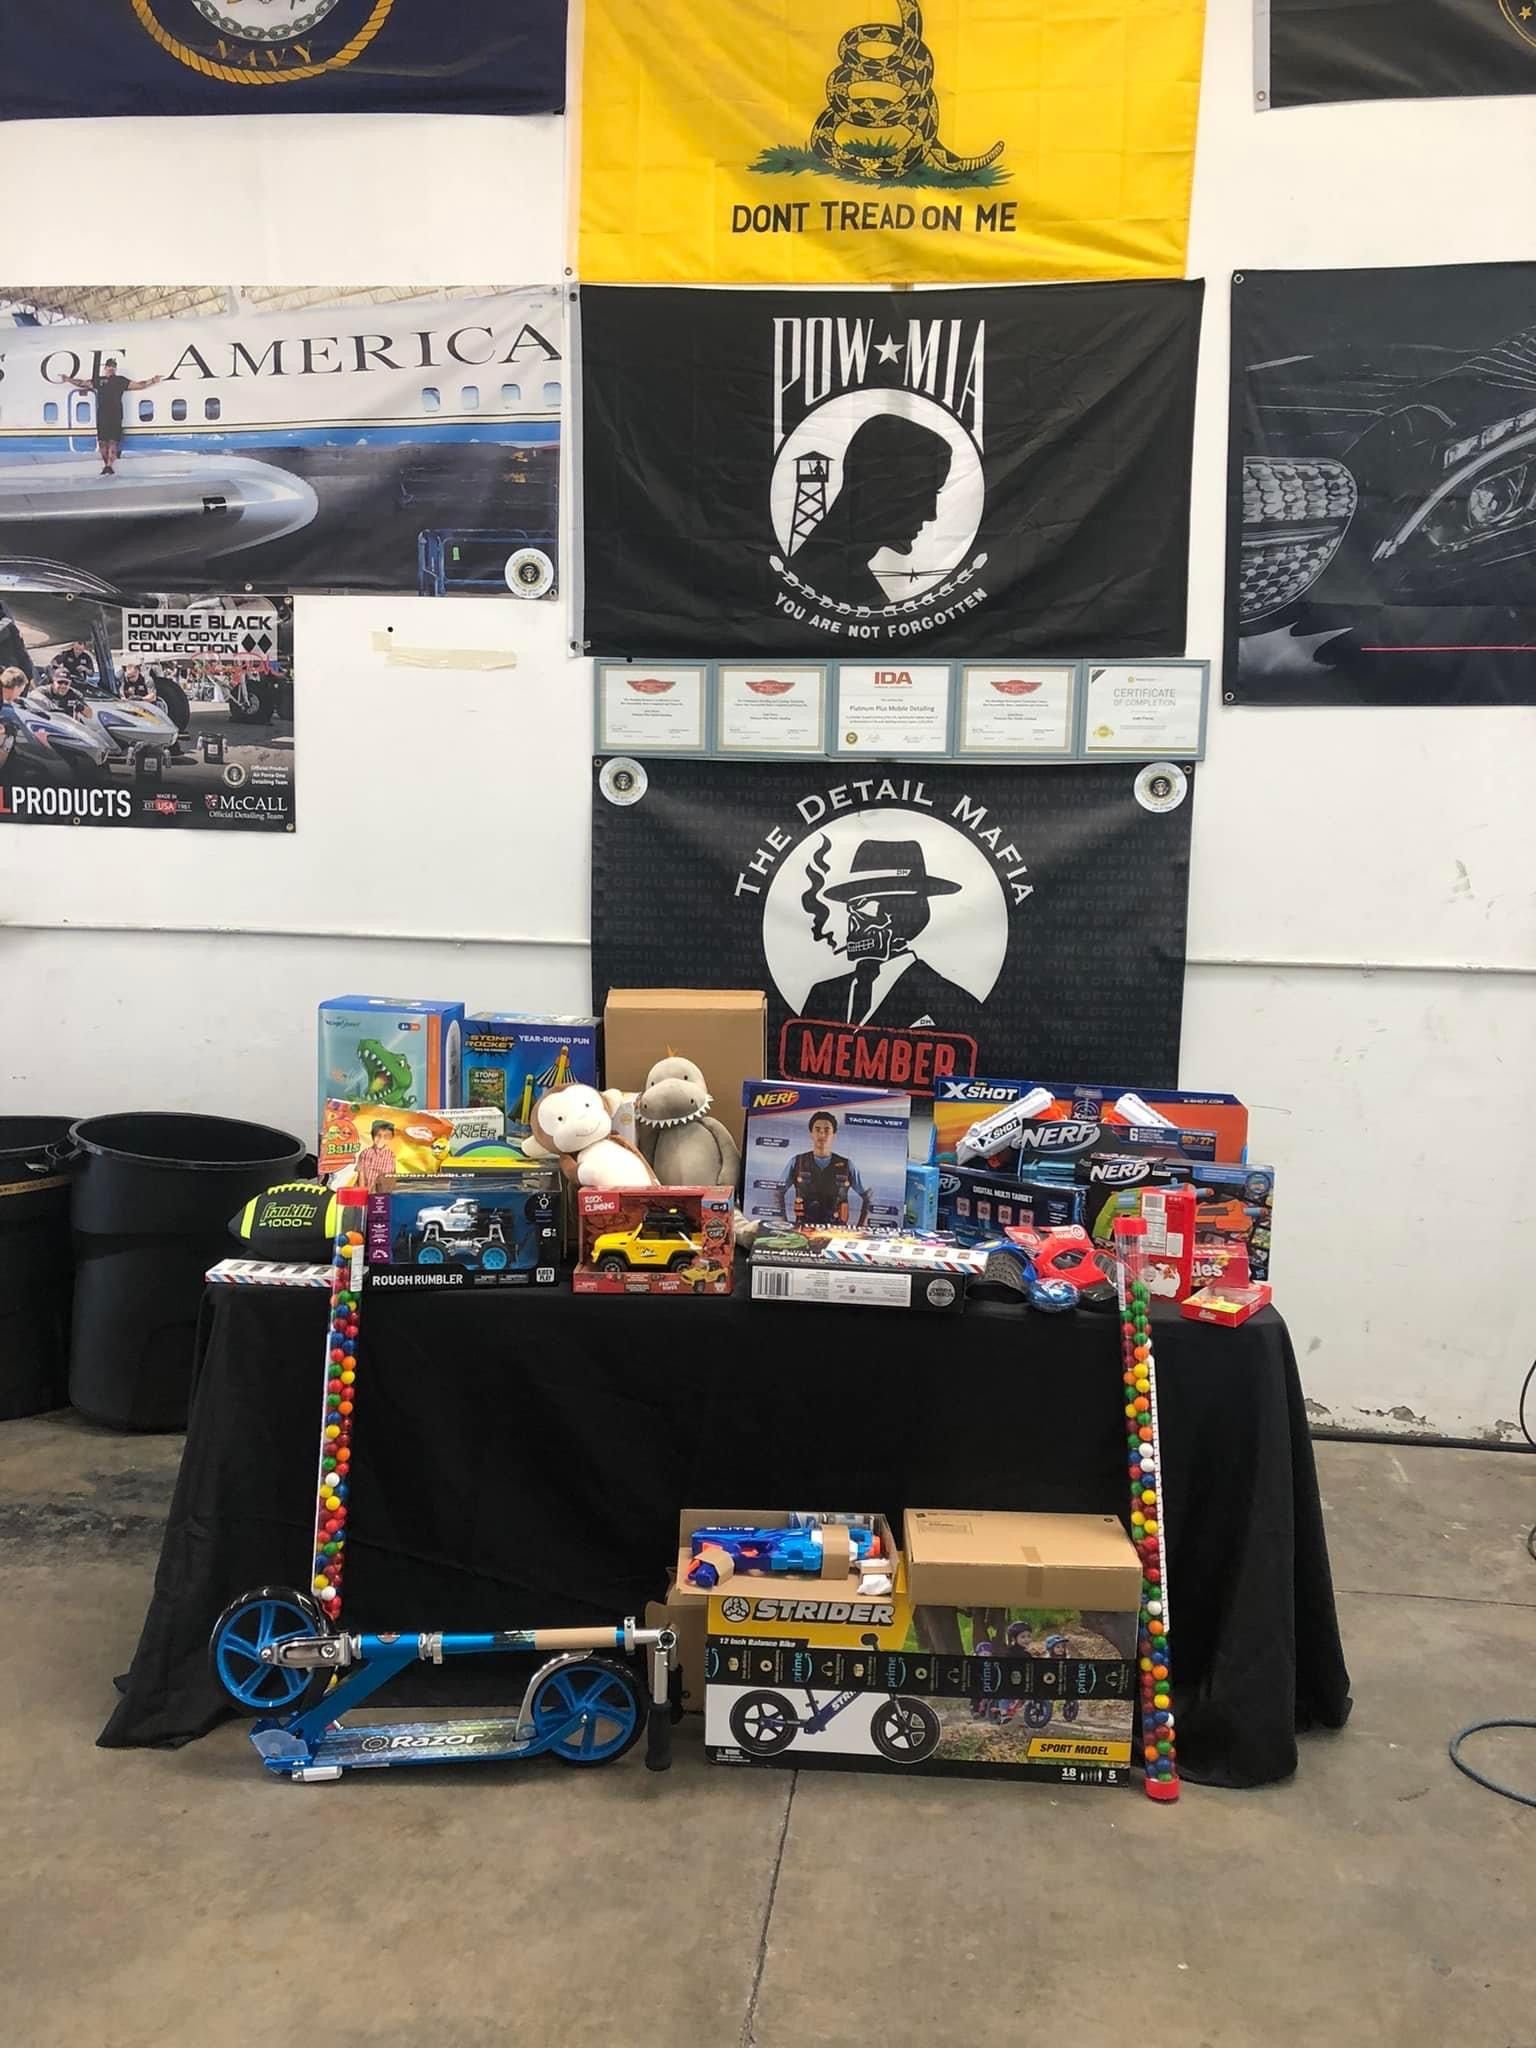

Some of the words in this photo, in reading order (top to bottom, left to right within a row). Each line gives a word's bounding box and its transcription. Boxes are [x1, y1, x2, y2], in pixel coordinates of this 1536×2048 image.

[216, 39, 314, 67] NAVY
[732, 201, 809, 233] DONT
[824, 201, 916, 231] TREAD
[922, 204, 962, 231] ON
[975, 201, 1017, 233] ME
[162, 322, 562, 381] AMERICA
[772, 317, 874, 456] POW
[903, 319, 987, 456] MIA
[774, 591, 803, 622] YOU
[808, 611, 841, 636] ARE
[848, 624, 881, 638] NOT
[888, 586, 989, 638] FORGOTTEN
[127, 614, 202, 629] DOUBLE
[208, 615, 273, 630] BLACK
[128, 631, 184, 642] RENNY
[188, 631, 238, 642] DOYLE
[128, 642, 238, 654] COLLECTION
[875, 672, 912, 684] IDA
[1113, 688, 1176, 698] CERTIFICATE
[1125, 699, 1176, 707] COMPLETION
[12, 786, 131, 817] PRODUCTS
[157, 801, 174, 811] USA
[220, 796, 287, 811] McCALL
[734, 824, 792, 898] THE
[796, 778, 934, 827] DETAIL
[950, 794, 1034, 907] MAFIA
[518, 1035, 571, 1045] YEAR-ROUND
[574, 1037, 590, 1045] FUN
[801, 1030, 956, 1085] MEMBER
[753, 1091, 799, 1108] NERF
[849, 1117, 882, 1125] TACTICAL
[1023, 1123, 1097, 1147] NERF
[327, 1142, 361, 1154] Balls
[1090, 1161, 1147, 1183] NERF
[372, 1275, 412, 1287] ROUGH
[415, 1273, 463, 1286] RUMBLER
[753, 1600, 895, 1626] STRIDER
[792, 1652, 803, 1683] prime
[885, 1657, 896, 1688] prime
[983, 1661, 993, 1693] prime
[1075, 1664, 1087, 1694] prime
[388, 1731, 485, 1749] Razor
[1040, 1743, 1072, 1753] SPORT
[1075, 1744, 1109, 1755] MODEL
[1062, 1768, 1077, 1777] 18
[1108, 1770, 1116, 1779] 5
